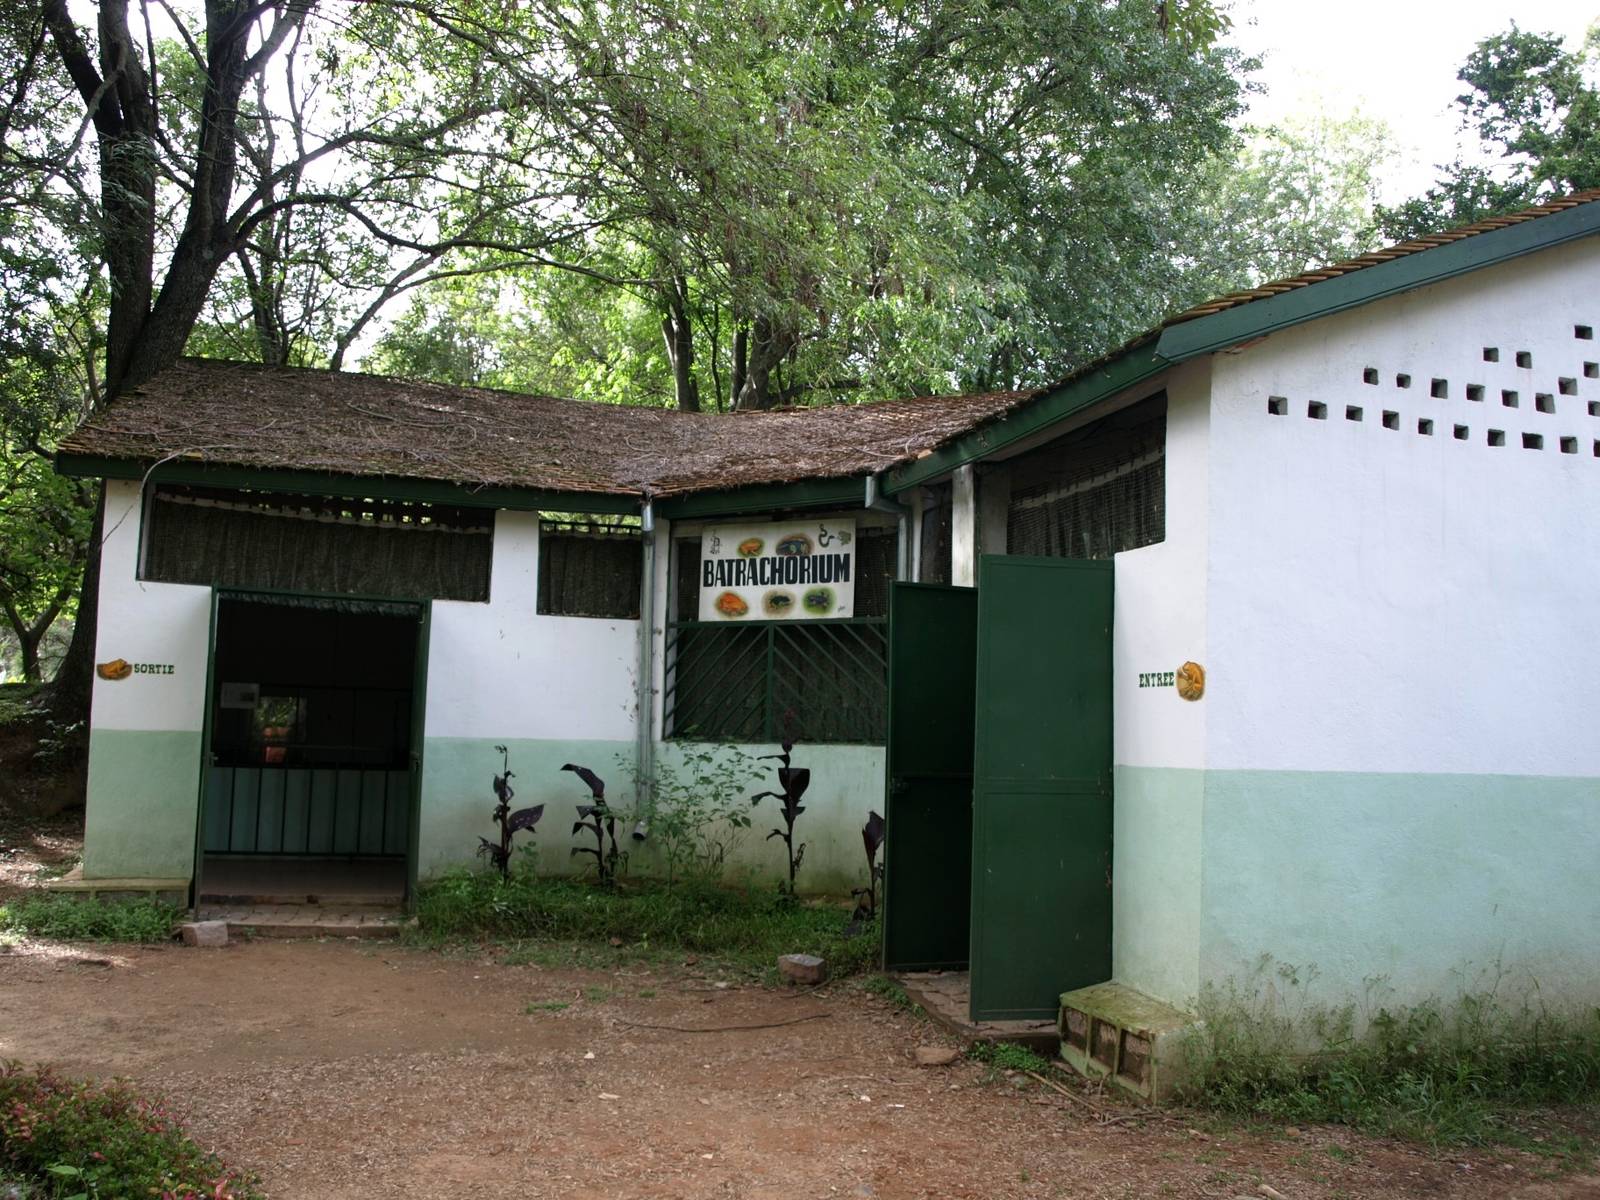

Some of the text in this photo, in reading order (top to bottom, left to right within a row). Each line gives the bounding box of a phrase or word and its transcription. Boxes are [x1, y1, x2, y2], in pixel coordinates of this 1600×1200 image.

[703, 553, 850, 587] BATRACHORIUM
[134, 663, 175, 675] SORTIE
[1139, 672, 1174, 688] ENTREE
